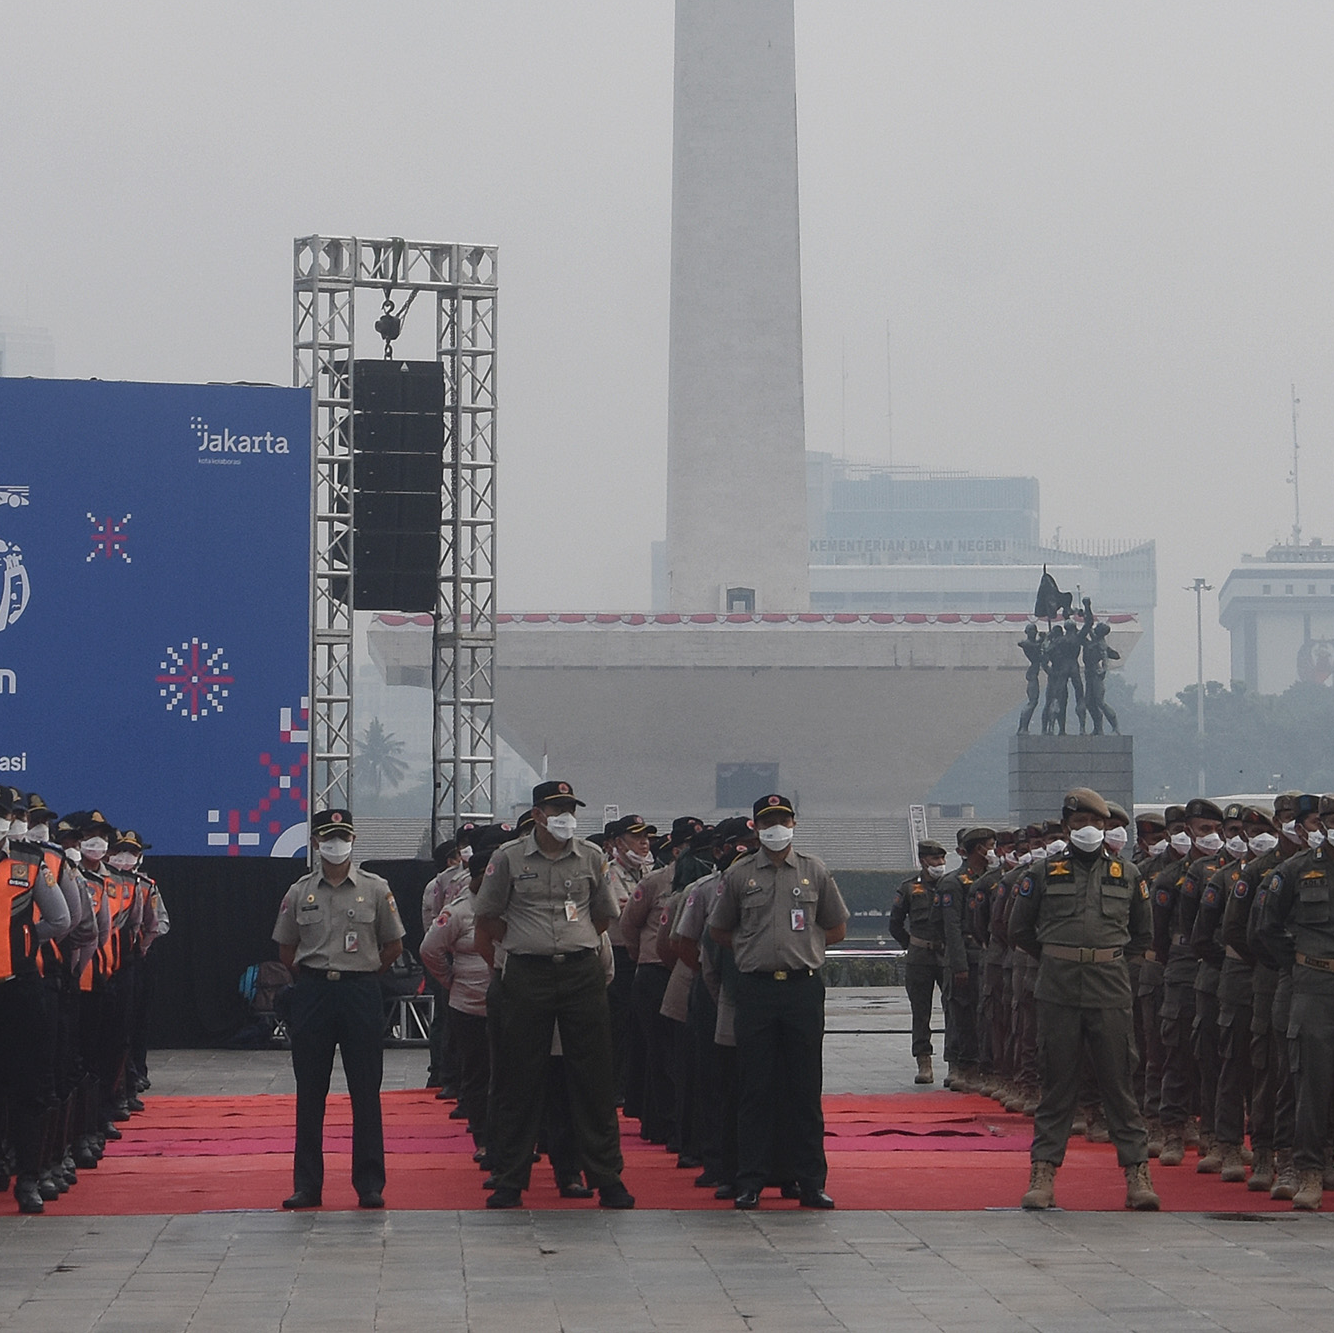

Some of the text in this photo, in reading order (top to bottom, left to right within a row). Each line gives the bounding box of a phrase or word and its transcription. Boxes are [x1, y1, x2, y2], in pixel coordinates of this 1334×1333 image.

[809, 539, 1007, 553] KEMENTERIAN DALAM NEGERI
